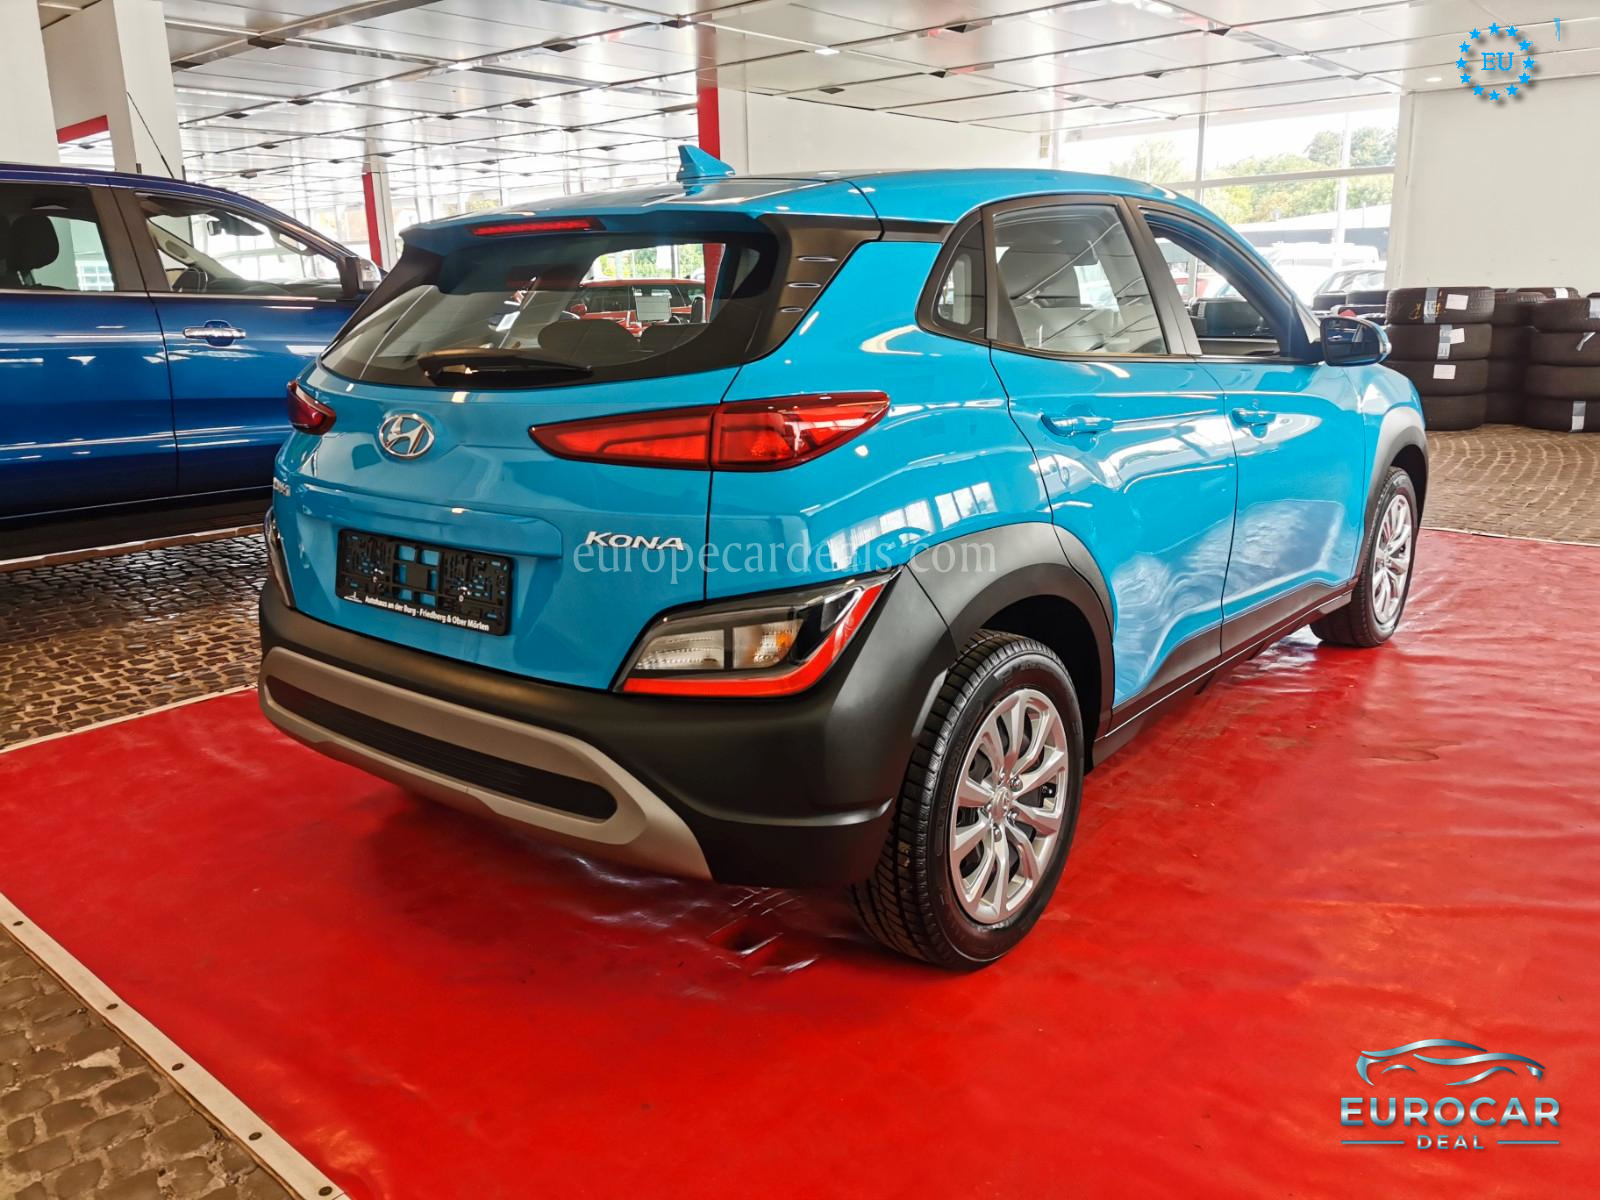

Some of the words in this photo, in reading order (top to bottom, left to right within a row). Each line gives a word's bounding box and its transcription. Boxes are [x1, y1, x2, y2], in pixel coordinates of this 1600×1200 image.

[584, 530, 684, 551] KONA
[419, 608, 447, 624] Friedberg
[452, 616, 467, 627] Ober
